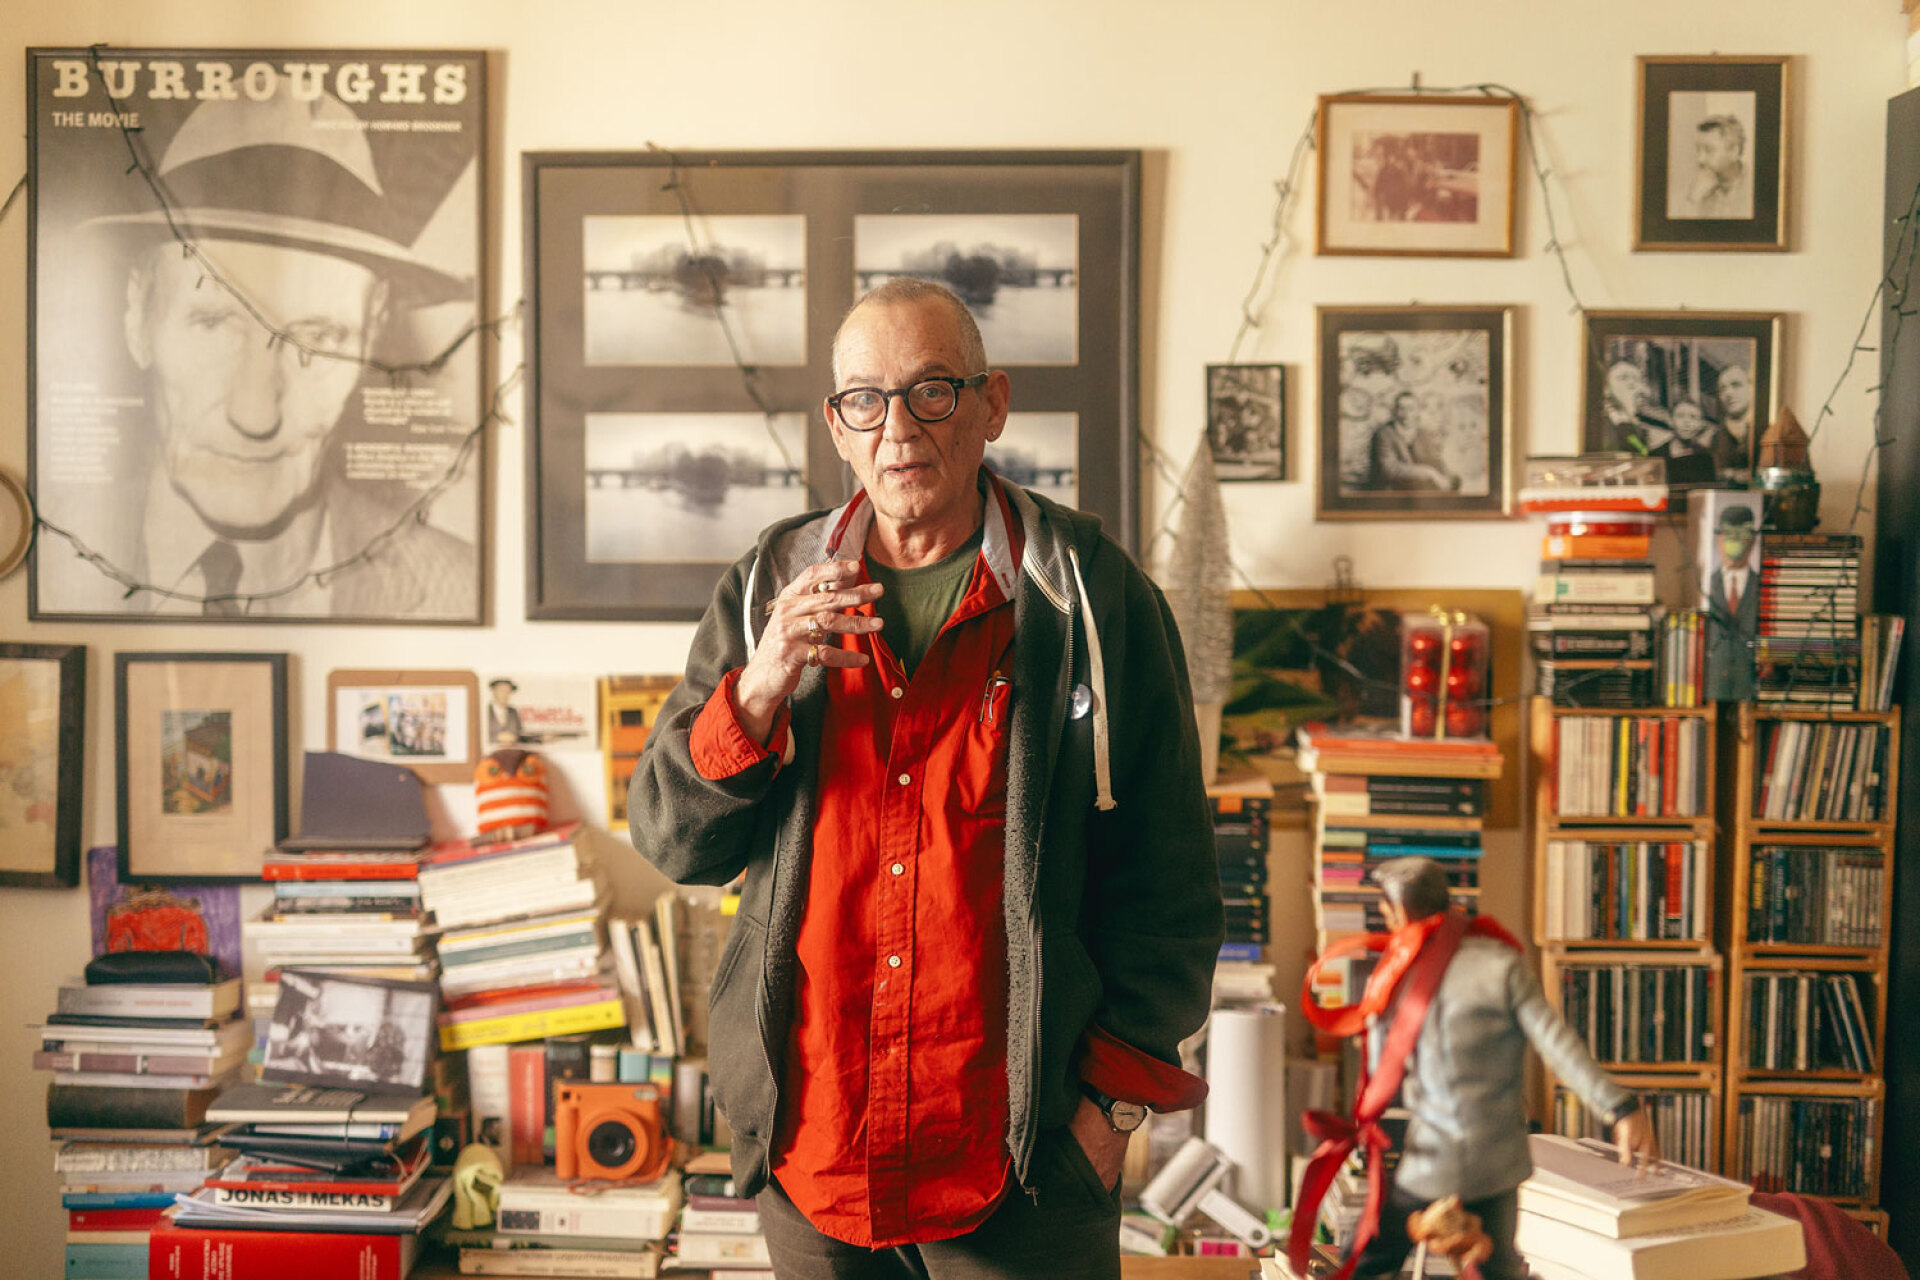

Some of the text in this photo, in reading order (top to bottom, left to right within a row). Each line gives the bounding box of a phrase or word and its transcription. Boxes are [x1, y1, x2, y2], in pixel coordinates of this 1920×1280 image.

[52, 60, 468, 105] BURROUGHS
[52, 112, 141, 128] THE MOVIE
[221, 1188, 293, 1205] JONAS
[311, 1191, 384, 1208] MEKAS
